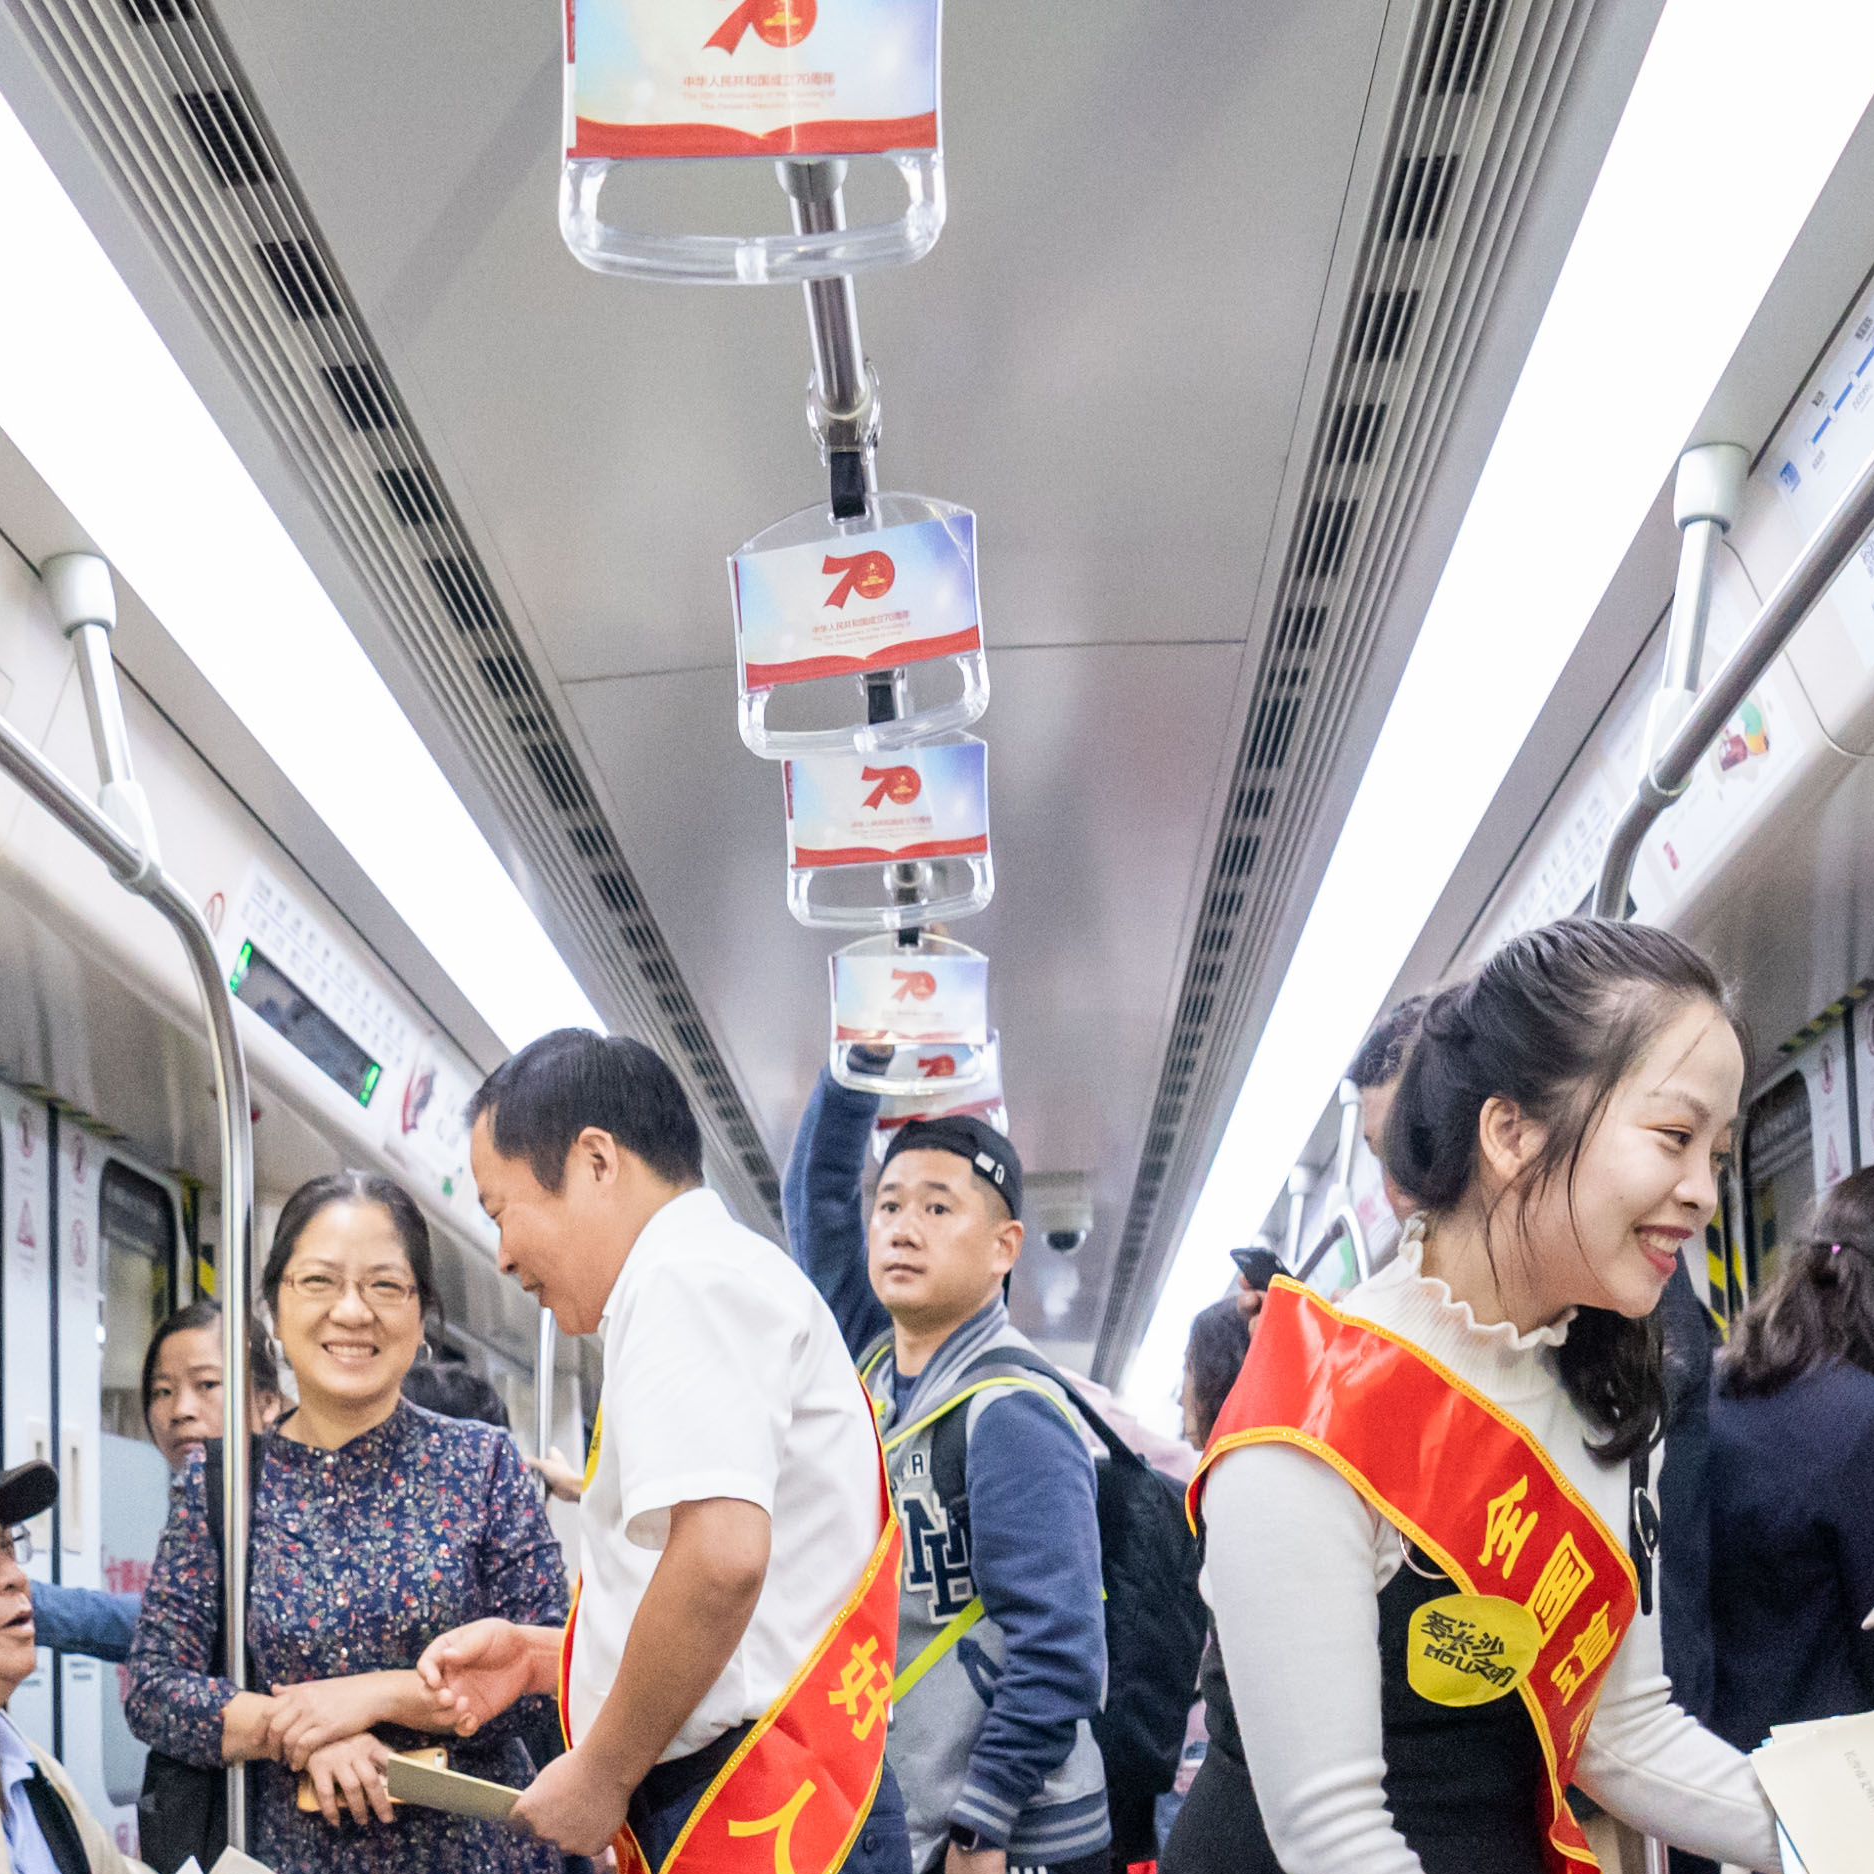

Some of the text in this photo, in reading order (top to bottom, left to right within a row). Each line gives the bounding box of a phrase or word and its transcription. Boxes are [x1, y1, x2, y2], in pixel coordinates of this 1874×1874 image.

[821, 550, 896, 609] 70
[861, 765, 922, 811] 70
[891, 969, 937, 1002] 70
[1420, 1610, 1505, 1660] 爱长沙
